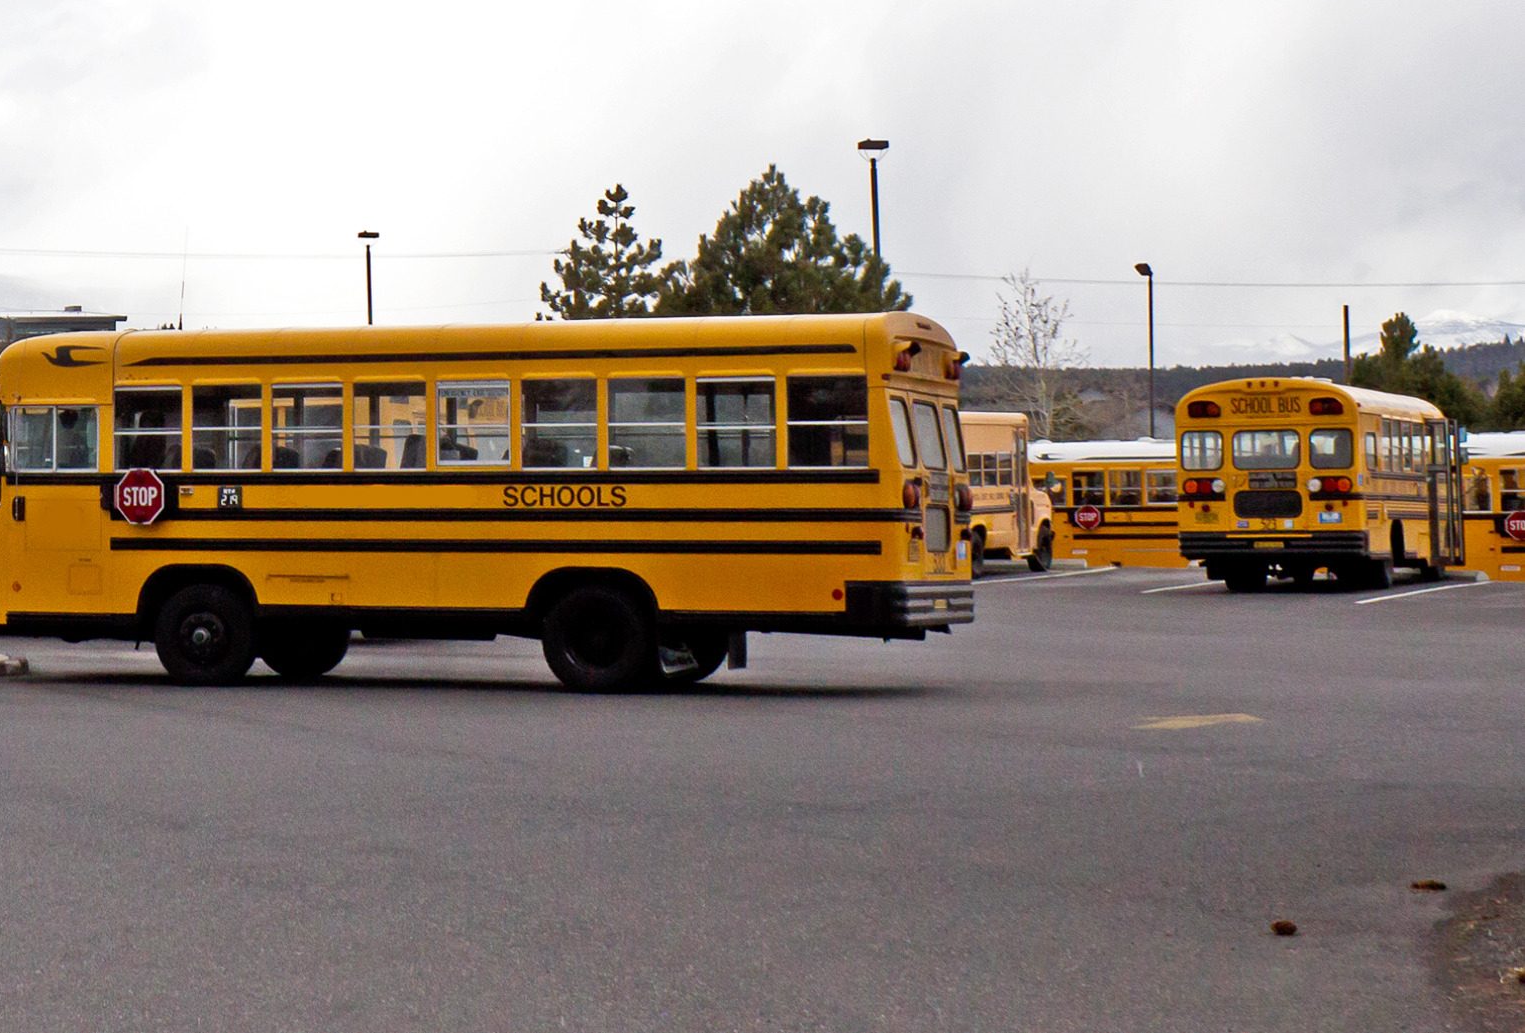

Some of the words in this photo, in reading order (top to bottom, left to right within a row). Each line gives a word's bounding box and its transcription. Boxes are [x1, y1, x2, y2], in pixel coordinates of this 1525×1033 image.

[1230, 396, 1274, 414] SCHOOL
[1277, 396, 1301, 413] BUS
[123, 486, 158, 507] STOP
[502, 485, 627, 507] SCHOOLS
[1078, 512, 1097, 522] STOP
[1509, 520, 1525, 531] STO
